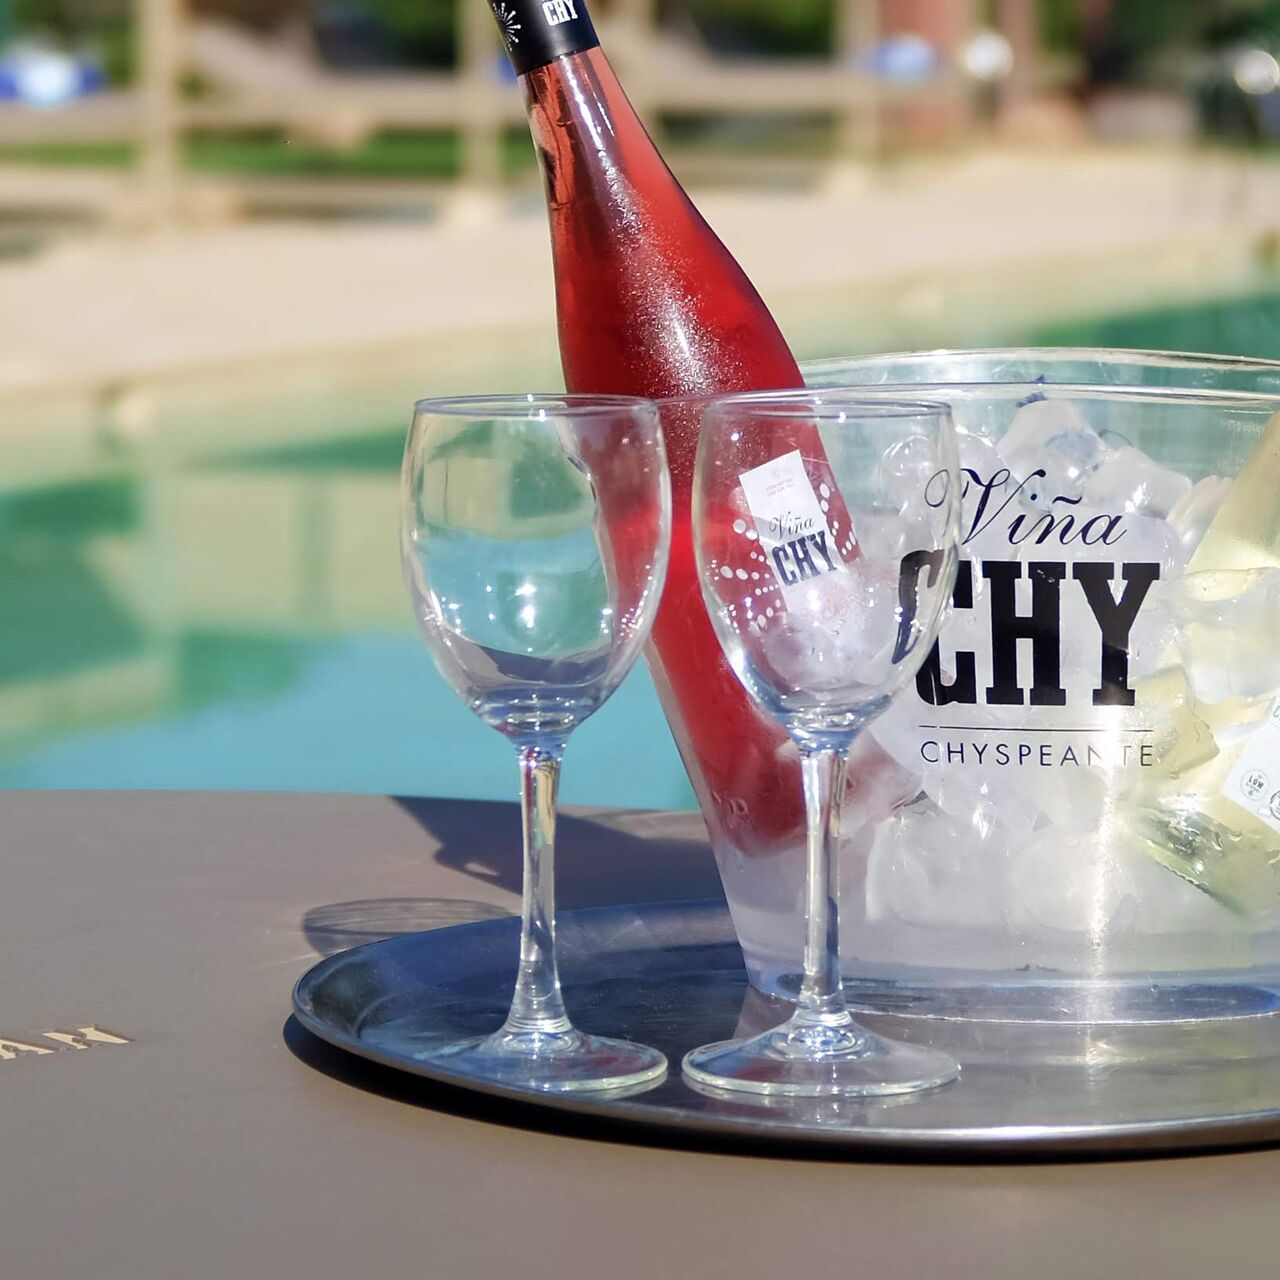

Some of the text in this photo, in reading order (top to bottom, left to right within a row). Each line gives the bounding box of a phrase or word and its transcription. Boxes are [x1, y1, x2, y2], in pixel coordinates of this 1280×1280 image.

[769, 512, 815, 540] Viña
[924, 467, 1128, 547] Viña
[771, 531, 838, 586] CHY
[892, 549, 1160, 708] CHY
[1248, 775, 1264, 789] LOW
